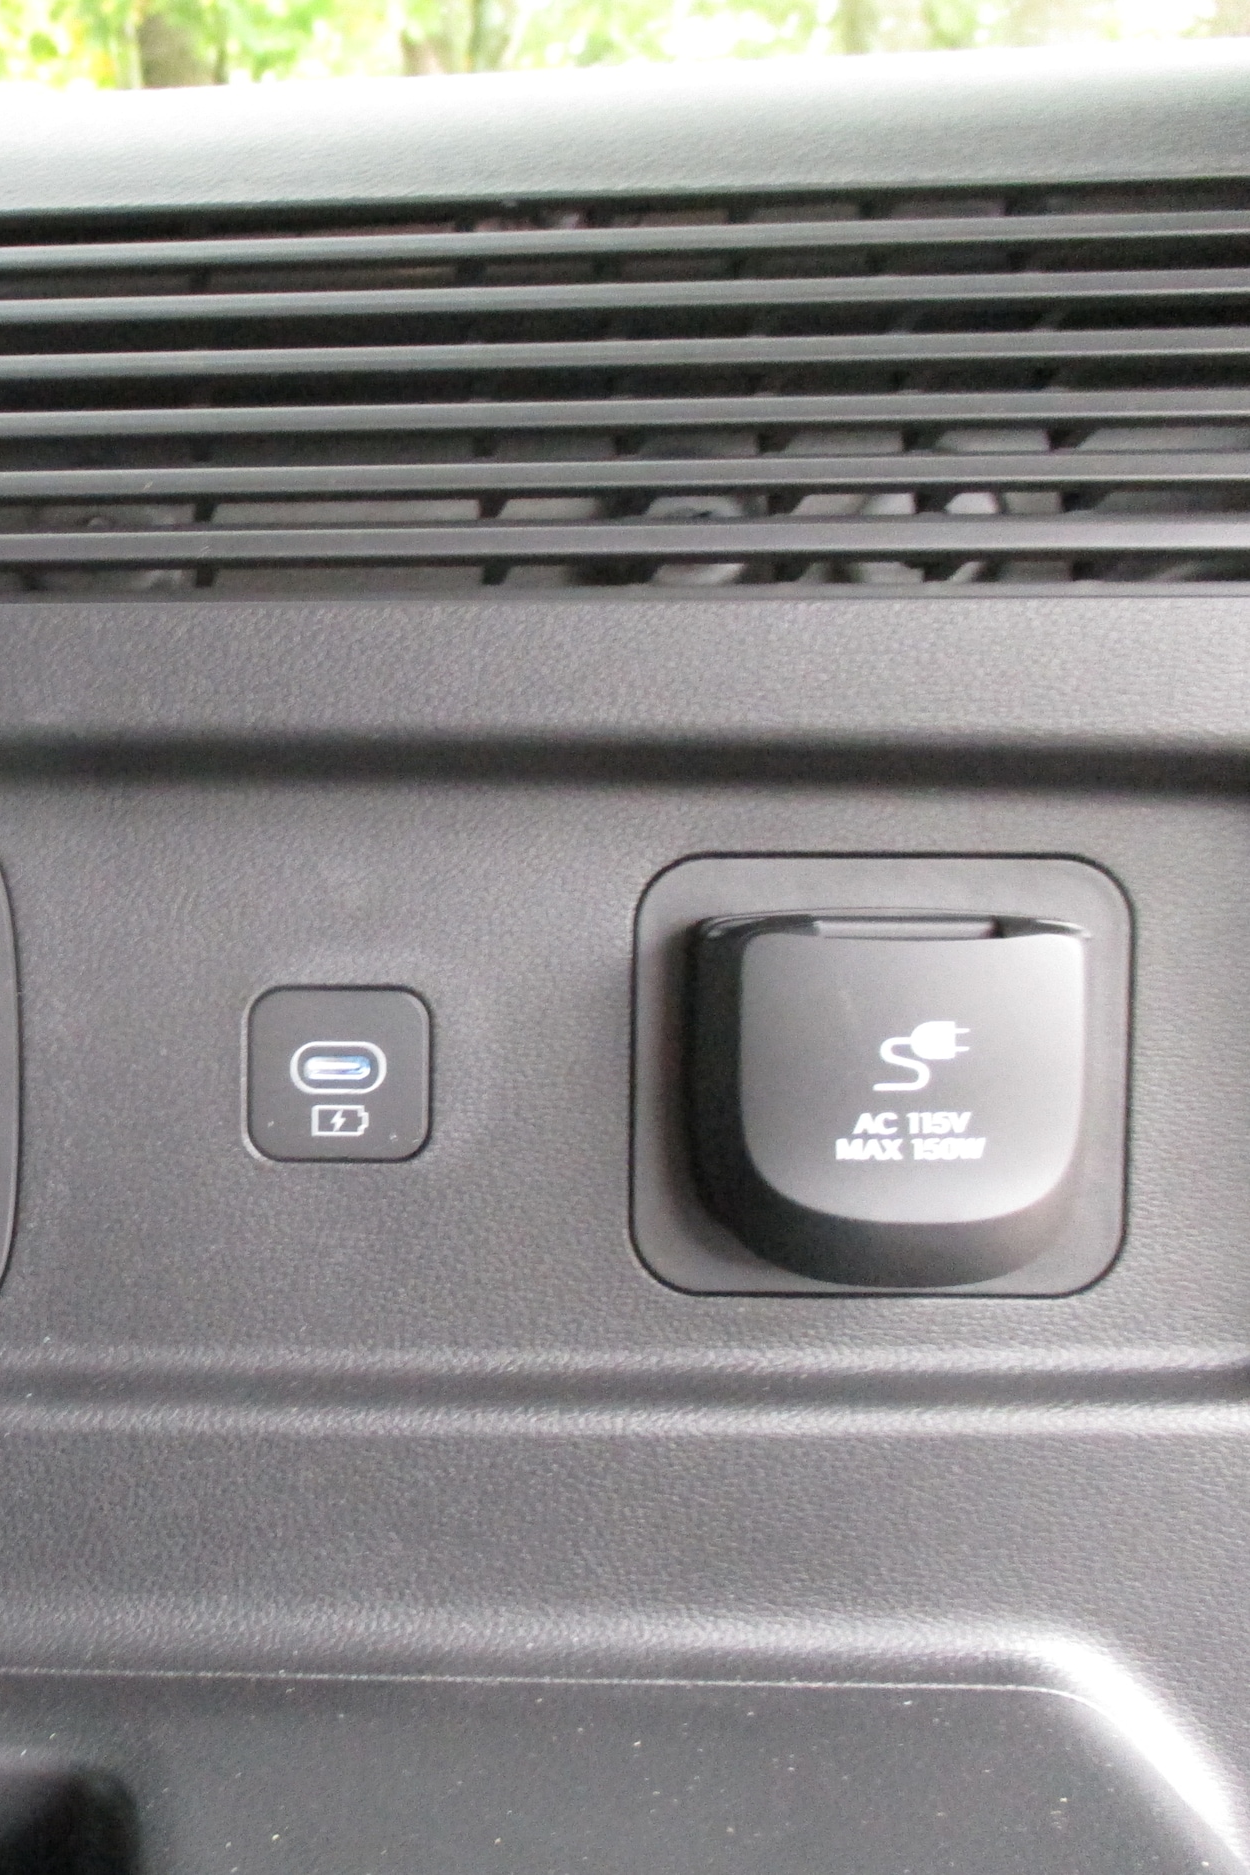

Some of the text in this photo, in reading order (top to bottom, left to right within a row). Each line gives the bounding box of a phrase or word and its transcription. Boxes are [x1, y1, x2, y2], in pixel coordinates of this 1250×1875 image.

[852, 1111, 972, 1135] AC 115V
[835, 1137, 986, 1160] MAX 150W
